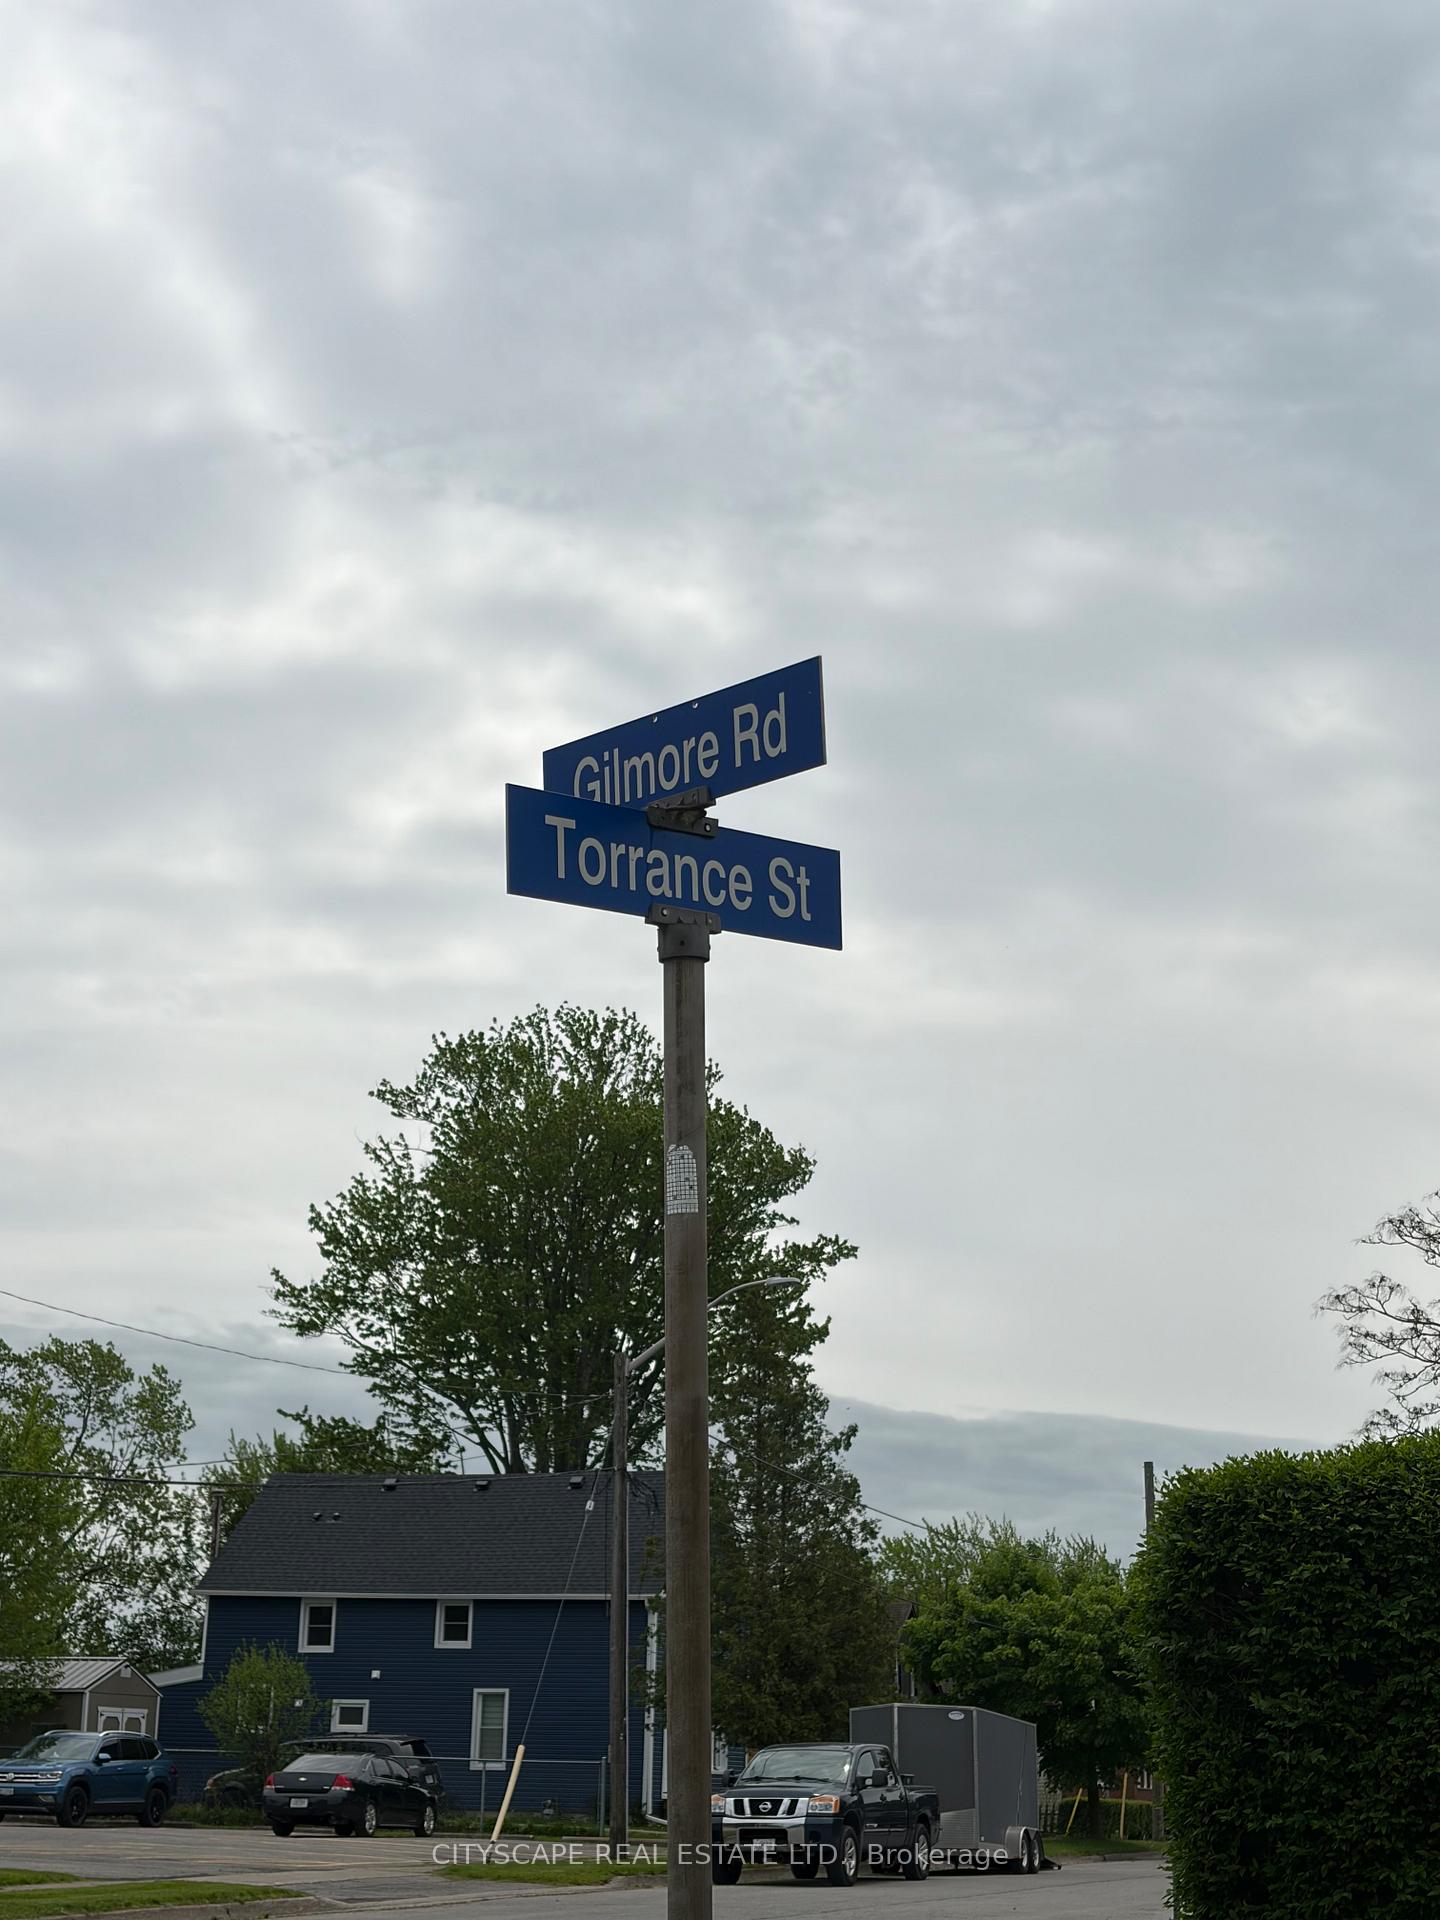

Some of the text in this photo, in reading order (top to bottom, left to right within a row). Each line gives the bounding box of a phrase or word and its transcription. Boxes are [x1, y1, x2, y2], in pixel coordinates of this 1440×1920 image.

[573, 692, 787, 806] Gilmore Rd
[545, 814, 812, 921] Torrance St
